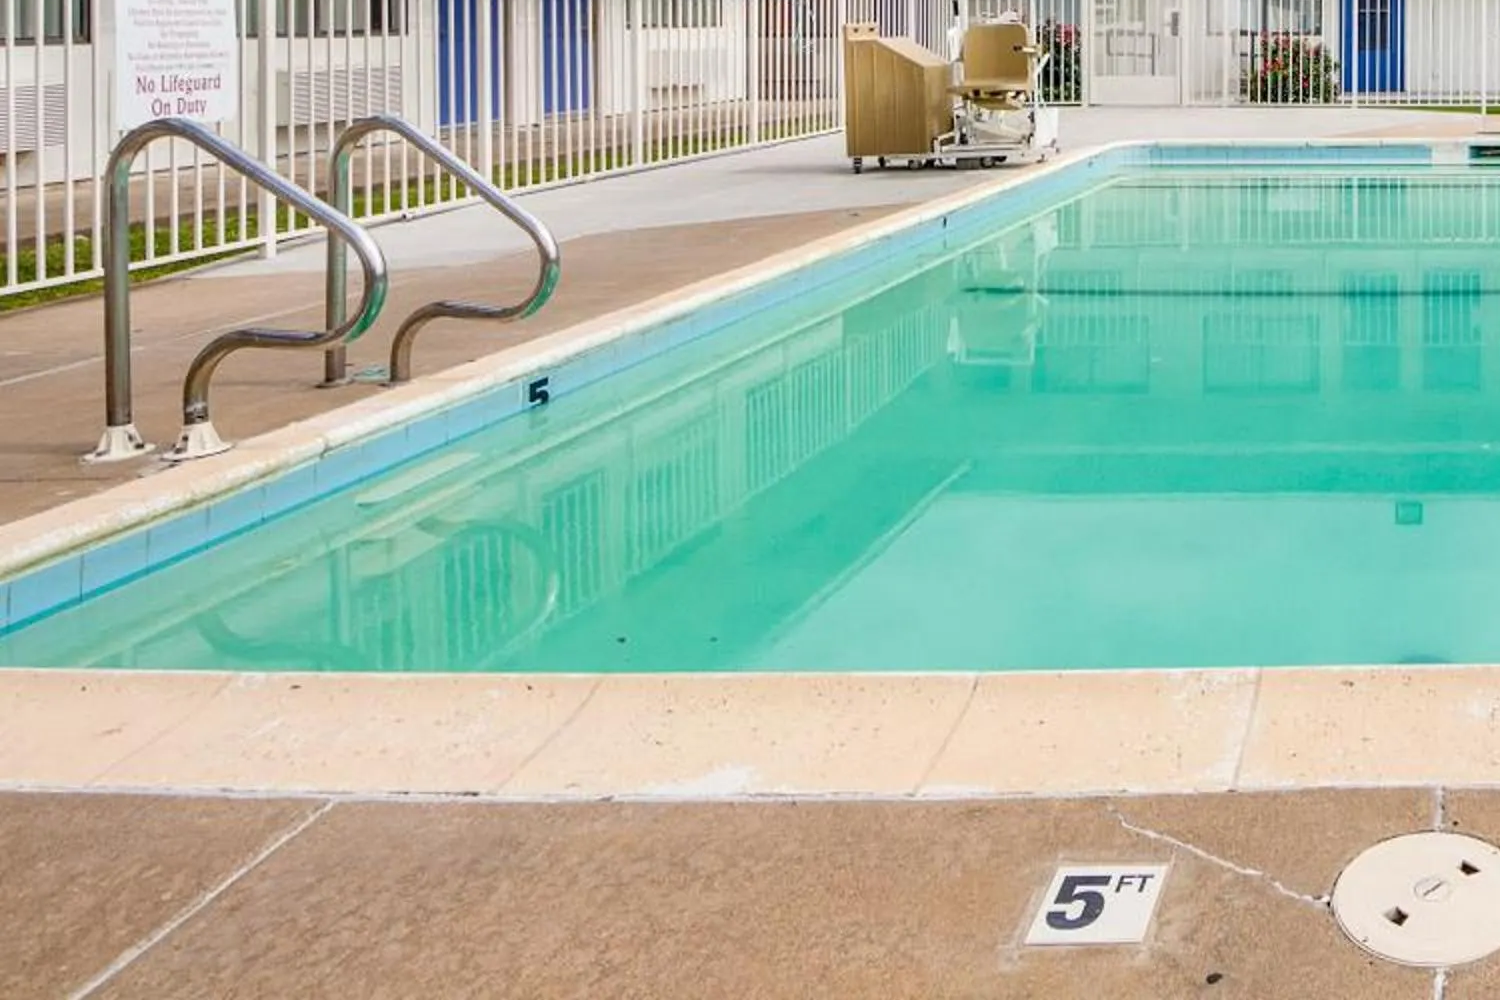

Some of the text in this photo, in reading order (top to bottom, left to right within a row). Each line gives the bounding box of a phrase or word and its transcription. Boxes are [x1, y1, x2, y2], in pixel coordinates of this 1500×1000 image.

[136, 73, 221, 95] No Lifeguard
[151, 98, 207, 116] On Duty
[529, 376, 549, 408] 5
[1045, 874, 1155, 930] 5 FT
